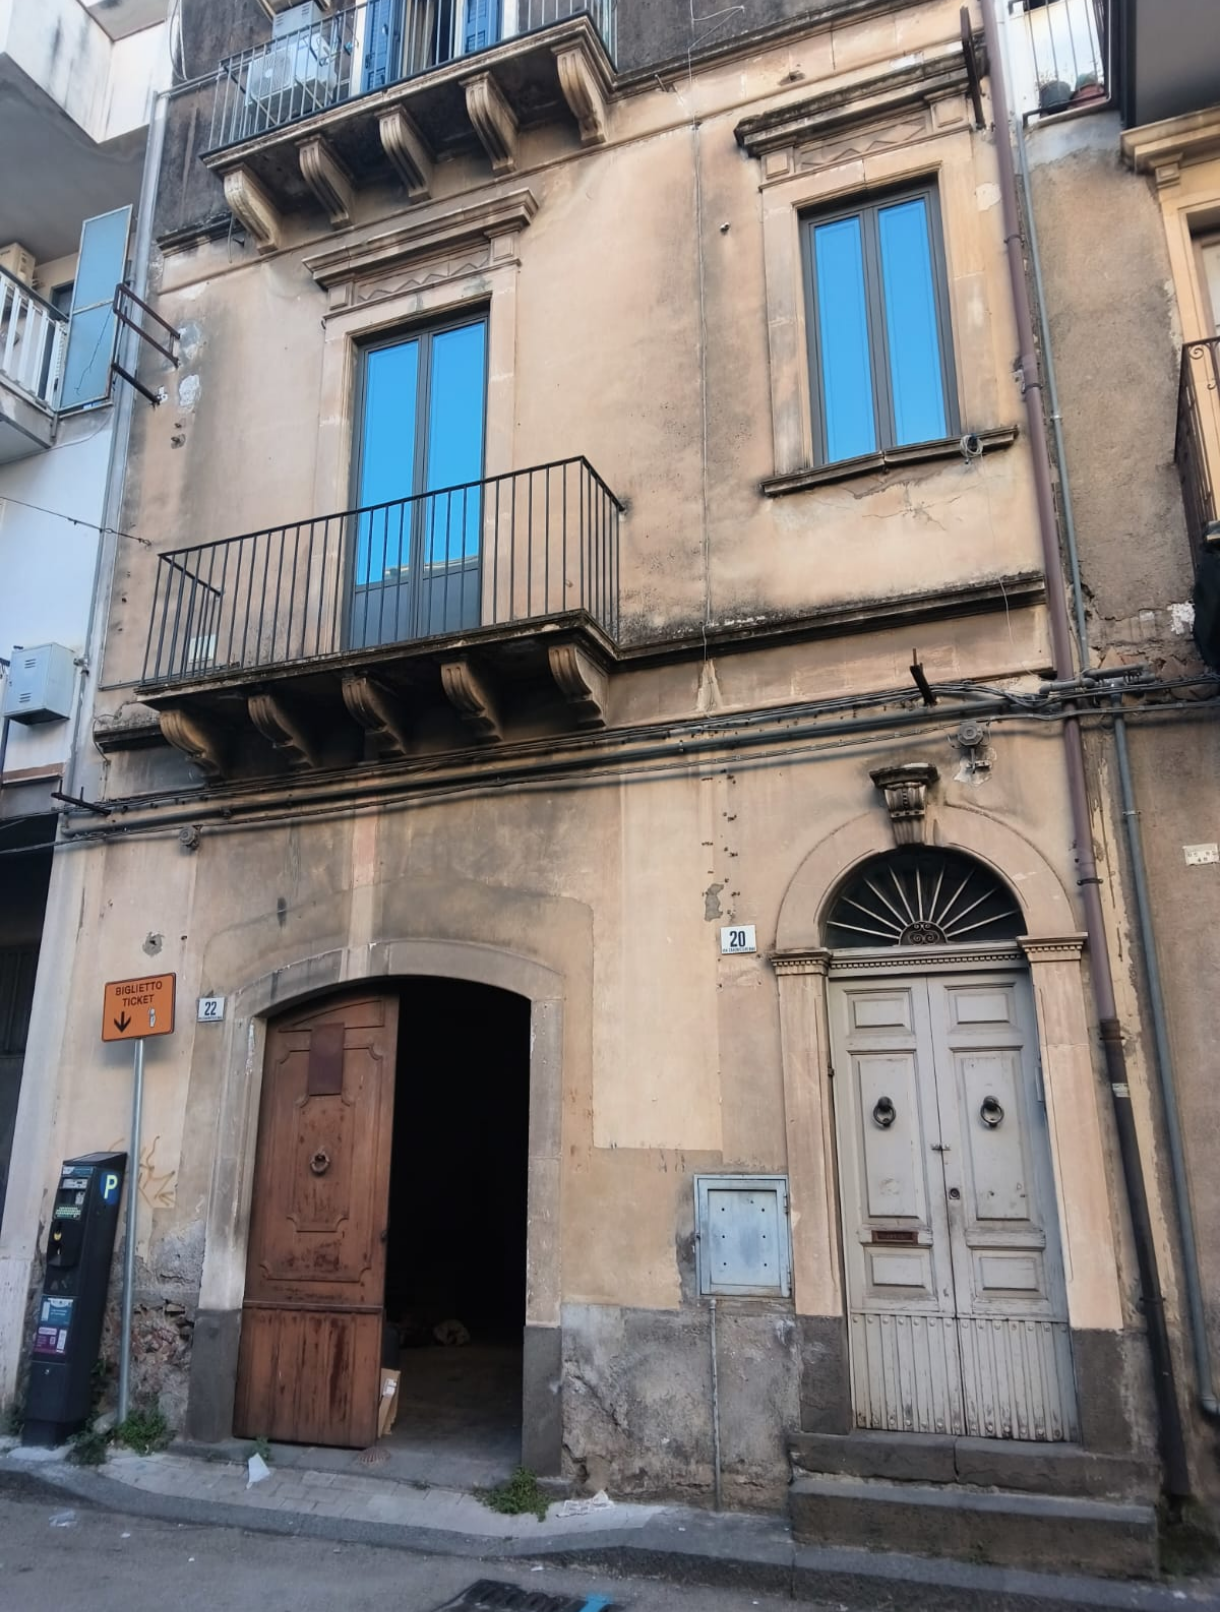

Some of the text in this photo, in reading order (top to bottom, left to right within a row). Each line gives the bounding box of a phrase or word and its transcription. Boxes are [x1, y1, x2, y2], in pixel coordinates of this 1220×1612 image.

[729, 930, 746, 947] 20
[115, 980, 163, 996] BIGLIETTO
[122, 994, 155, 1007] TICKET
[204, 1001, 218, 1016] 22
[103, 1174, 118, 1199] P
